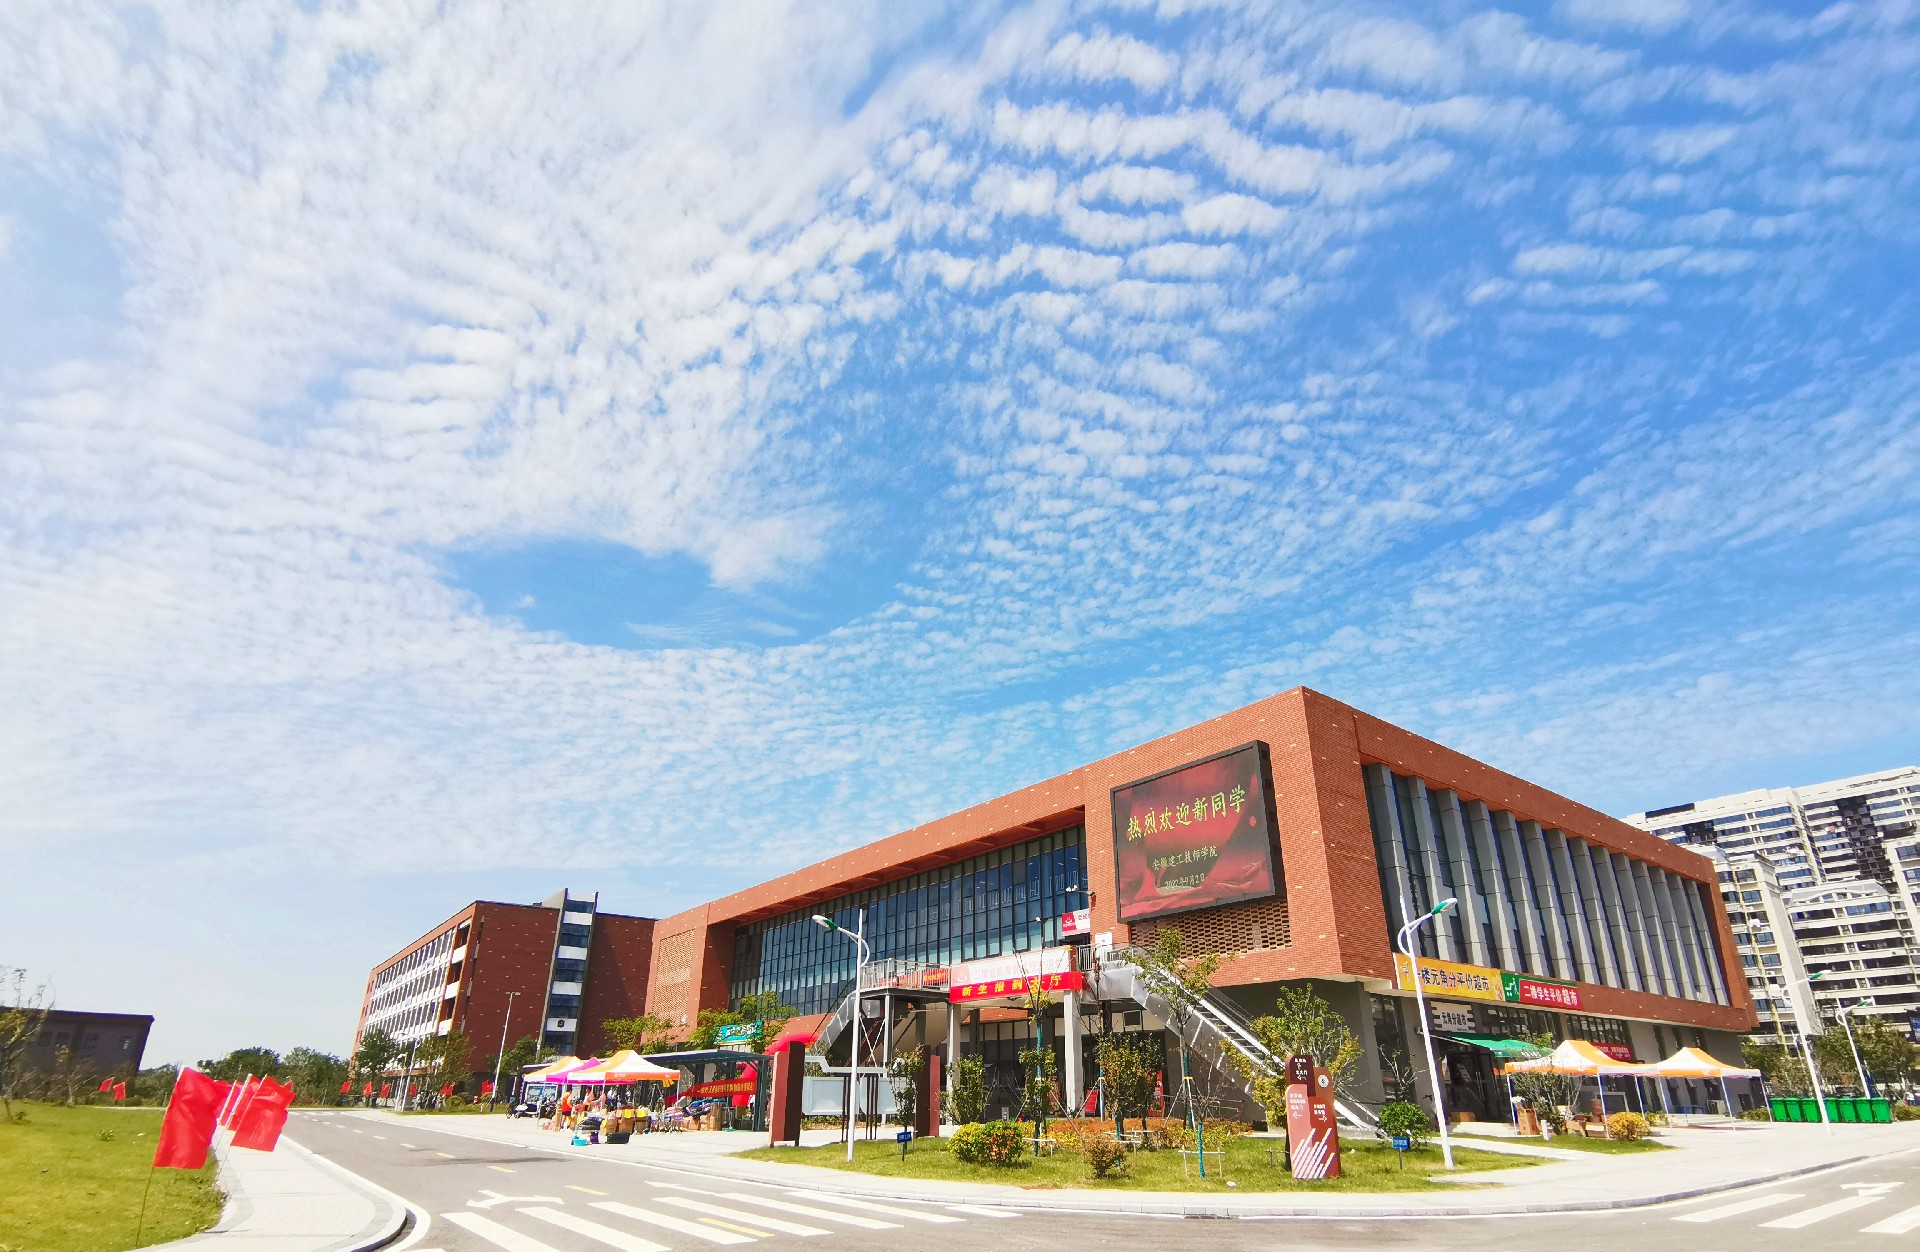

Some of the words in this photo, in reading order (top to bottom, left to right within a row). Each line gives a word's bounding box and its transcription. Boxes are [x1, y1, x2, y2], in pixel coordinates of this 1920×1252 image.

[1126, 783, 1247, 842] 热烈欢迎新同学
[1151, 845, 1218, 871] 安徽建工技师学院
[961, 974, 1062, 997] 新生报到大厅
[1524, 984, 1578, 1006] 二楼学生平价超市
